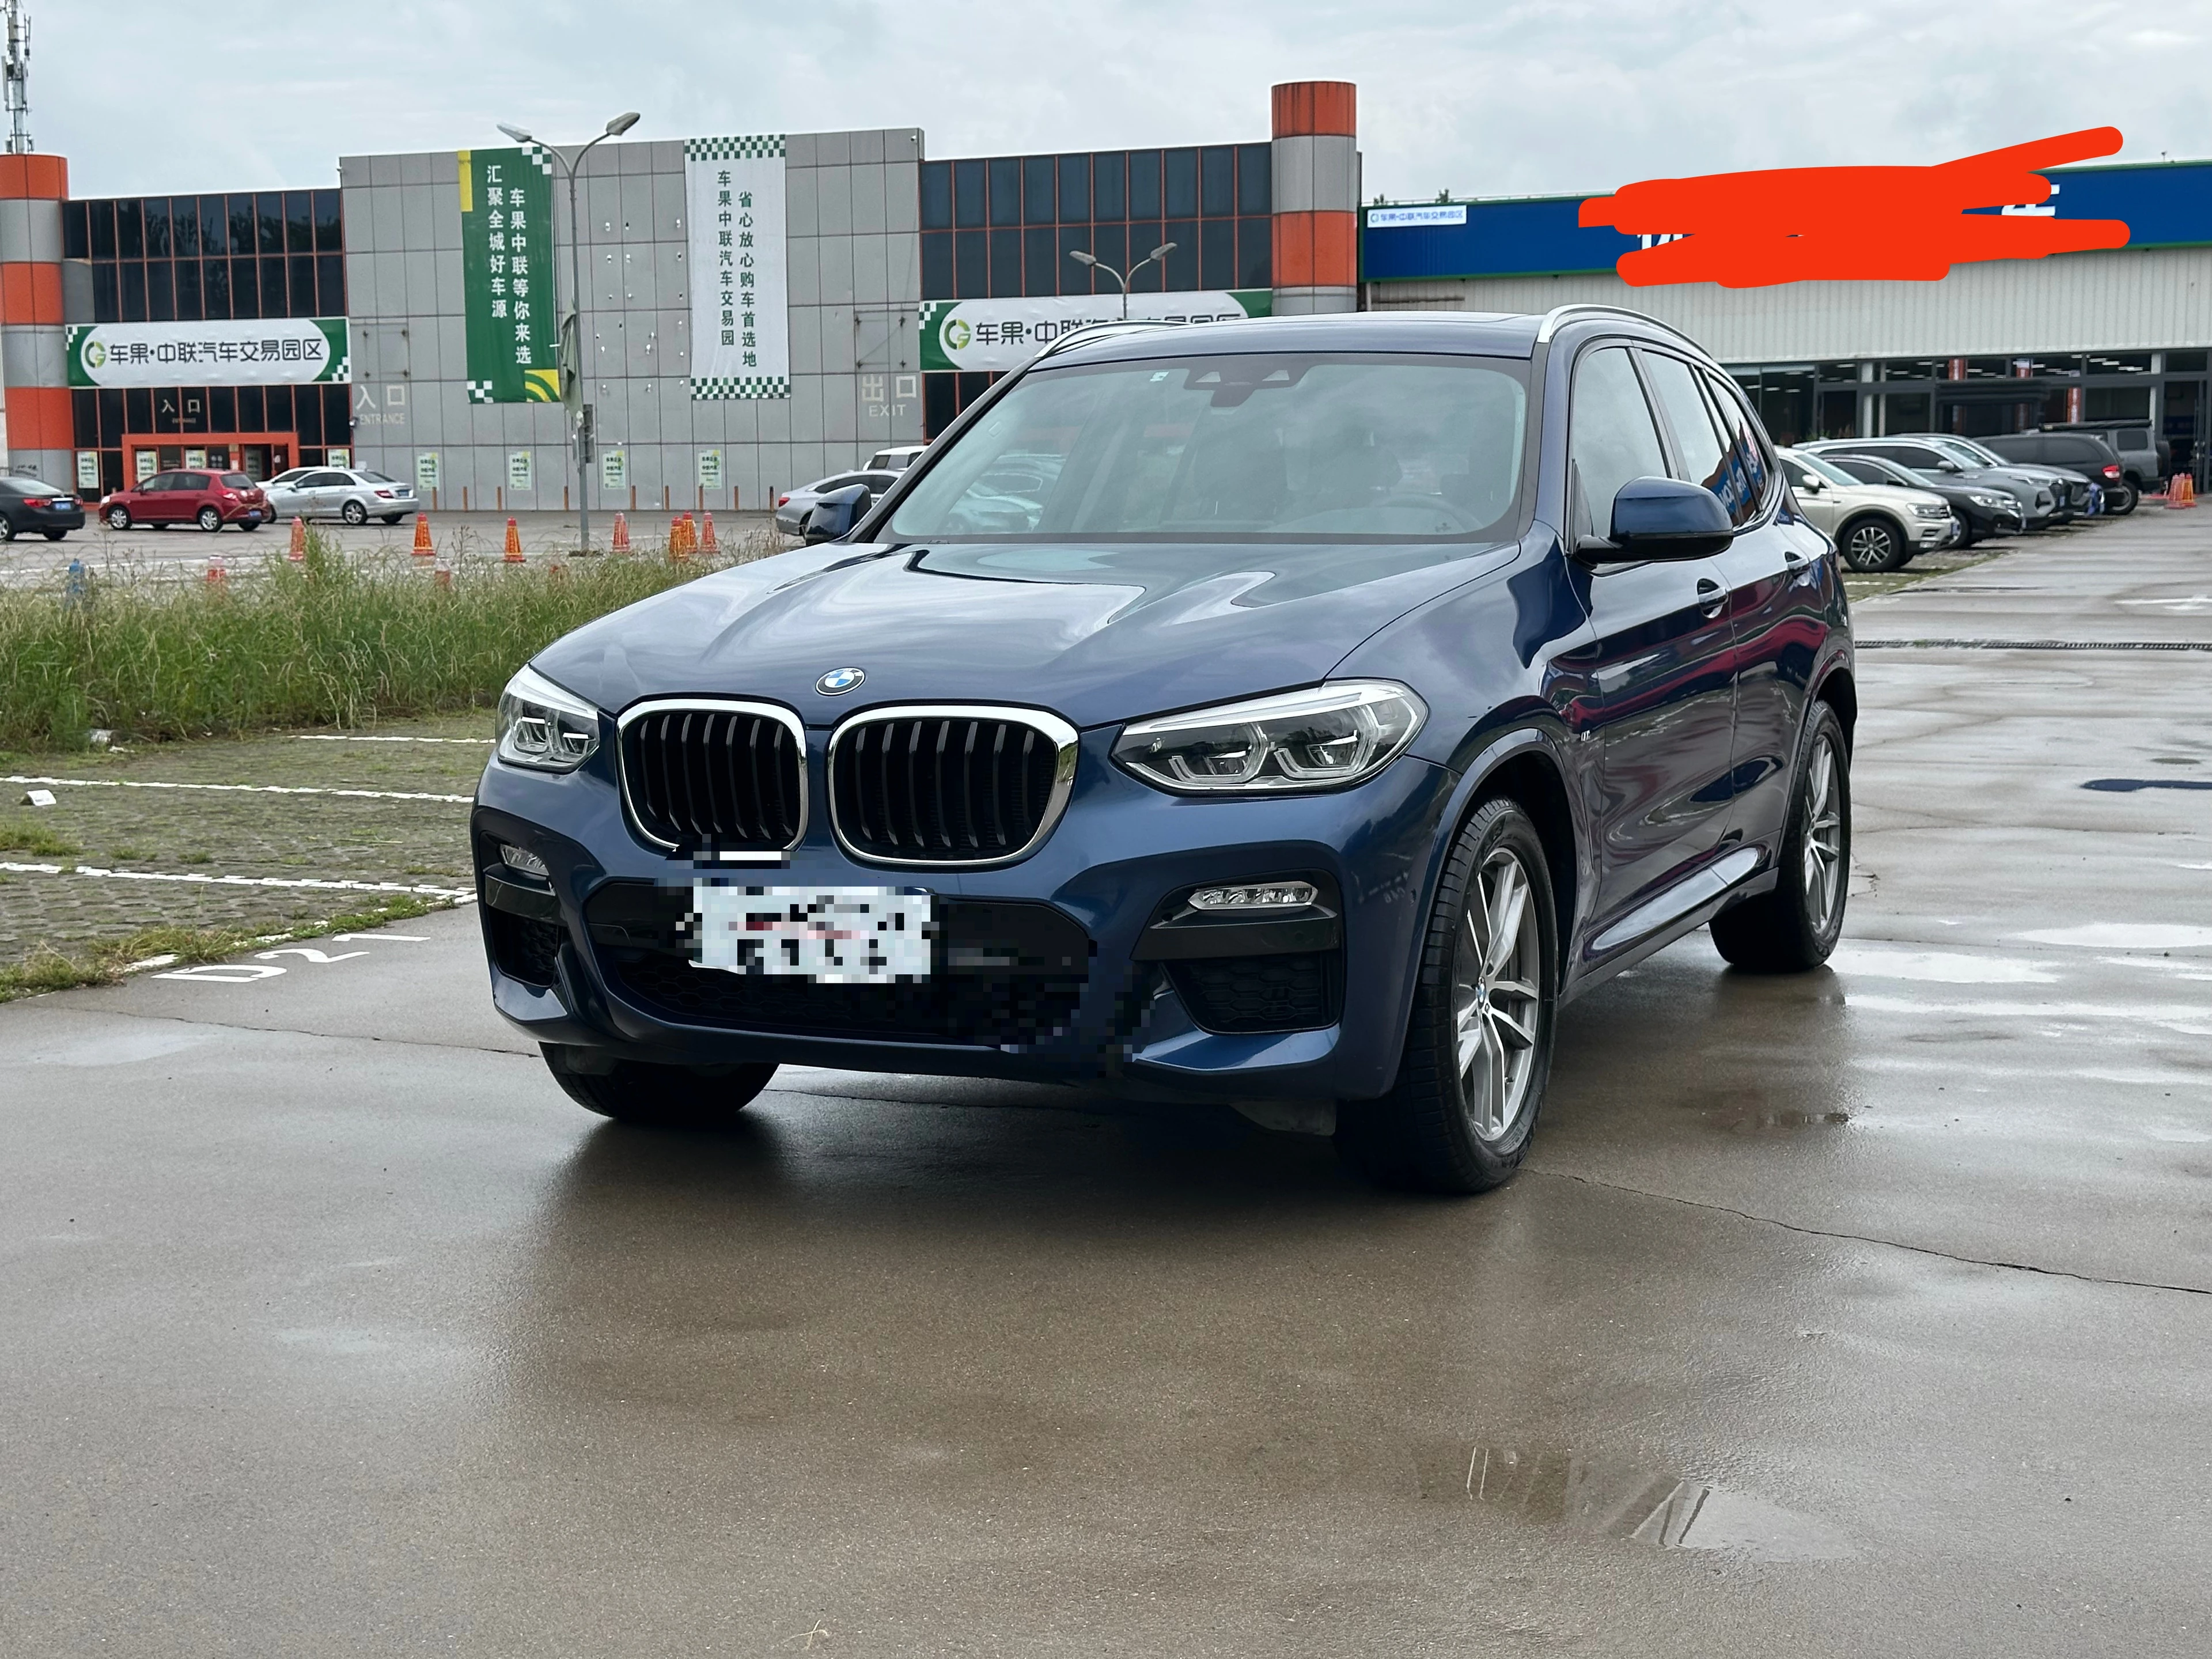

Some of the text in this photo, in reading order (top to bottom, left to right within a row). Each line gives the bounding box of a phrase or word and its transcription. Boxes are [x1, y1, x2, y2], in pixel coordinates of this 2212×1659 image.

[487, 165, 507, 319] 汇聚全城好车源
[717, 170, 734, 346] 车果中联汽车交易园
[509, 187, 532, 364] 车果中联等你来选
[738, 191, 757, 368] 省心放心购车首选地
[110, 338, 323, 365] 车果·中联汽车交易园区
[355, 384, 406, 410] 入口
[862, 373, 917, 402] 出口
[161, 398, 200, 414] 入口
[359, 412, 405, 426] ENTRANCE
[869, 404, 907, 417] EXIT
